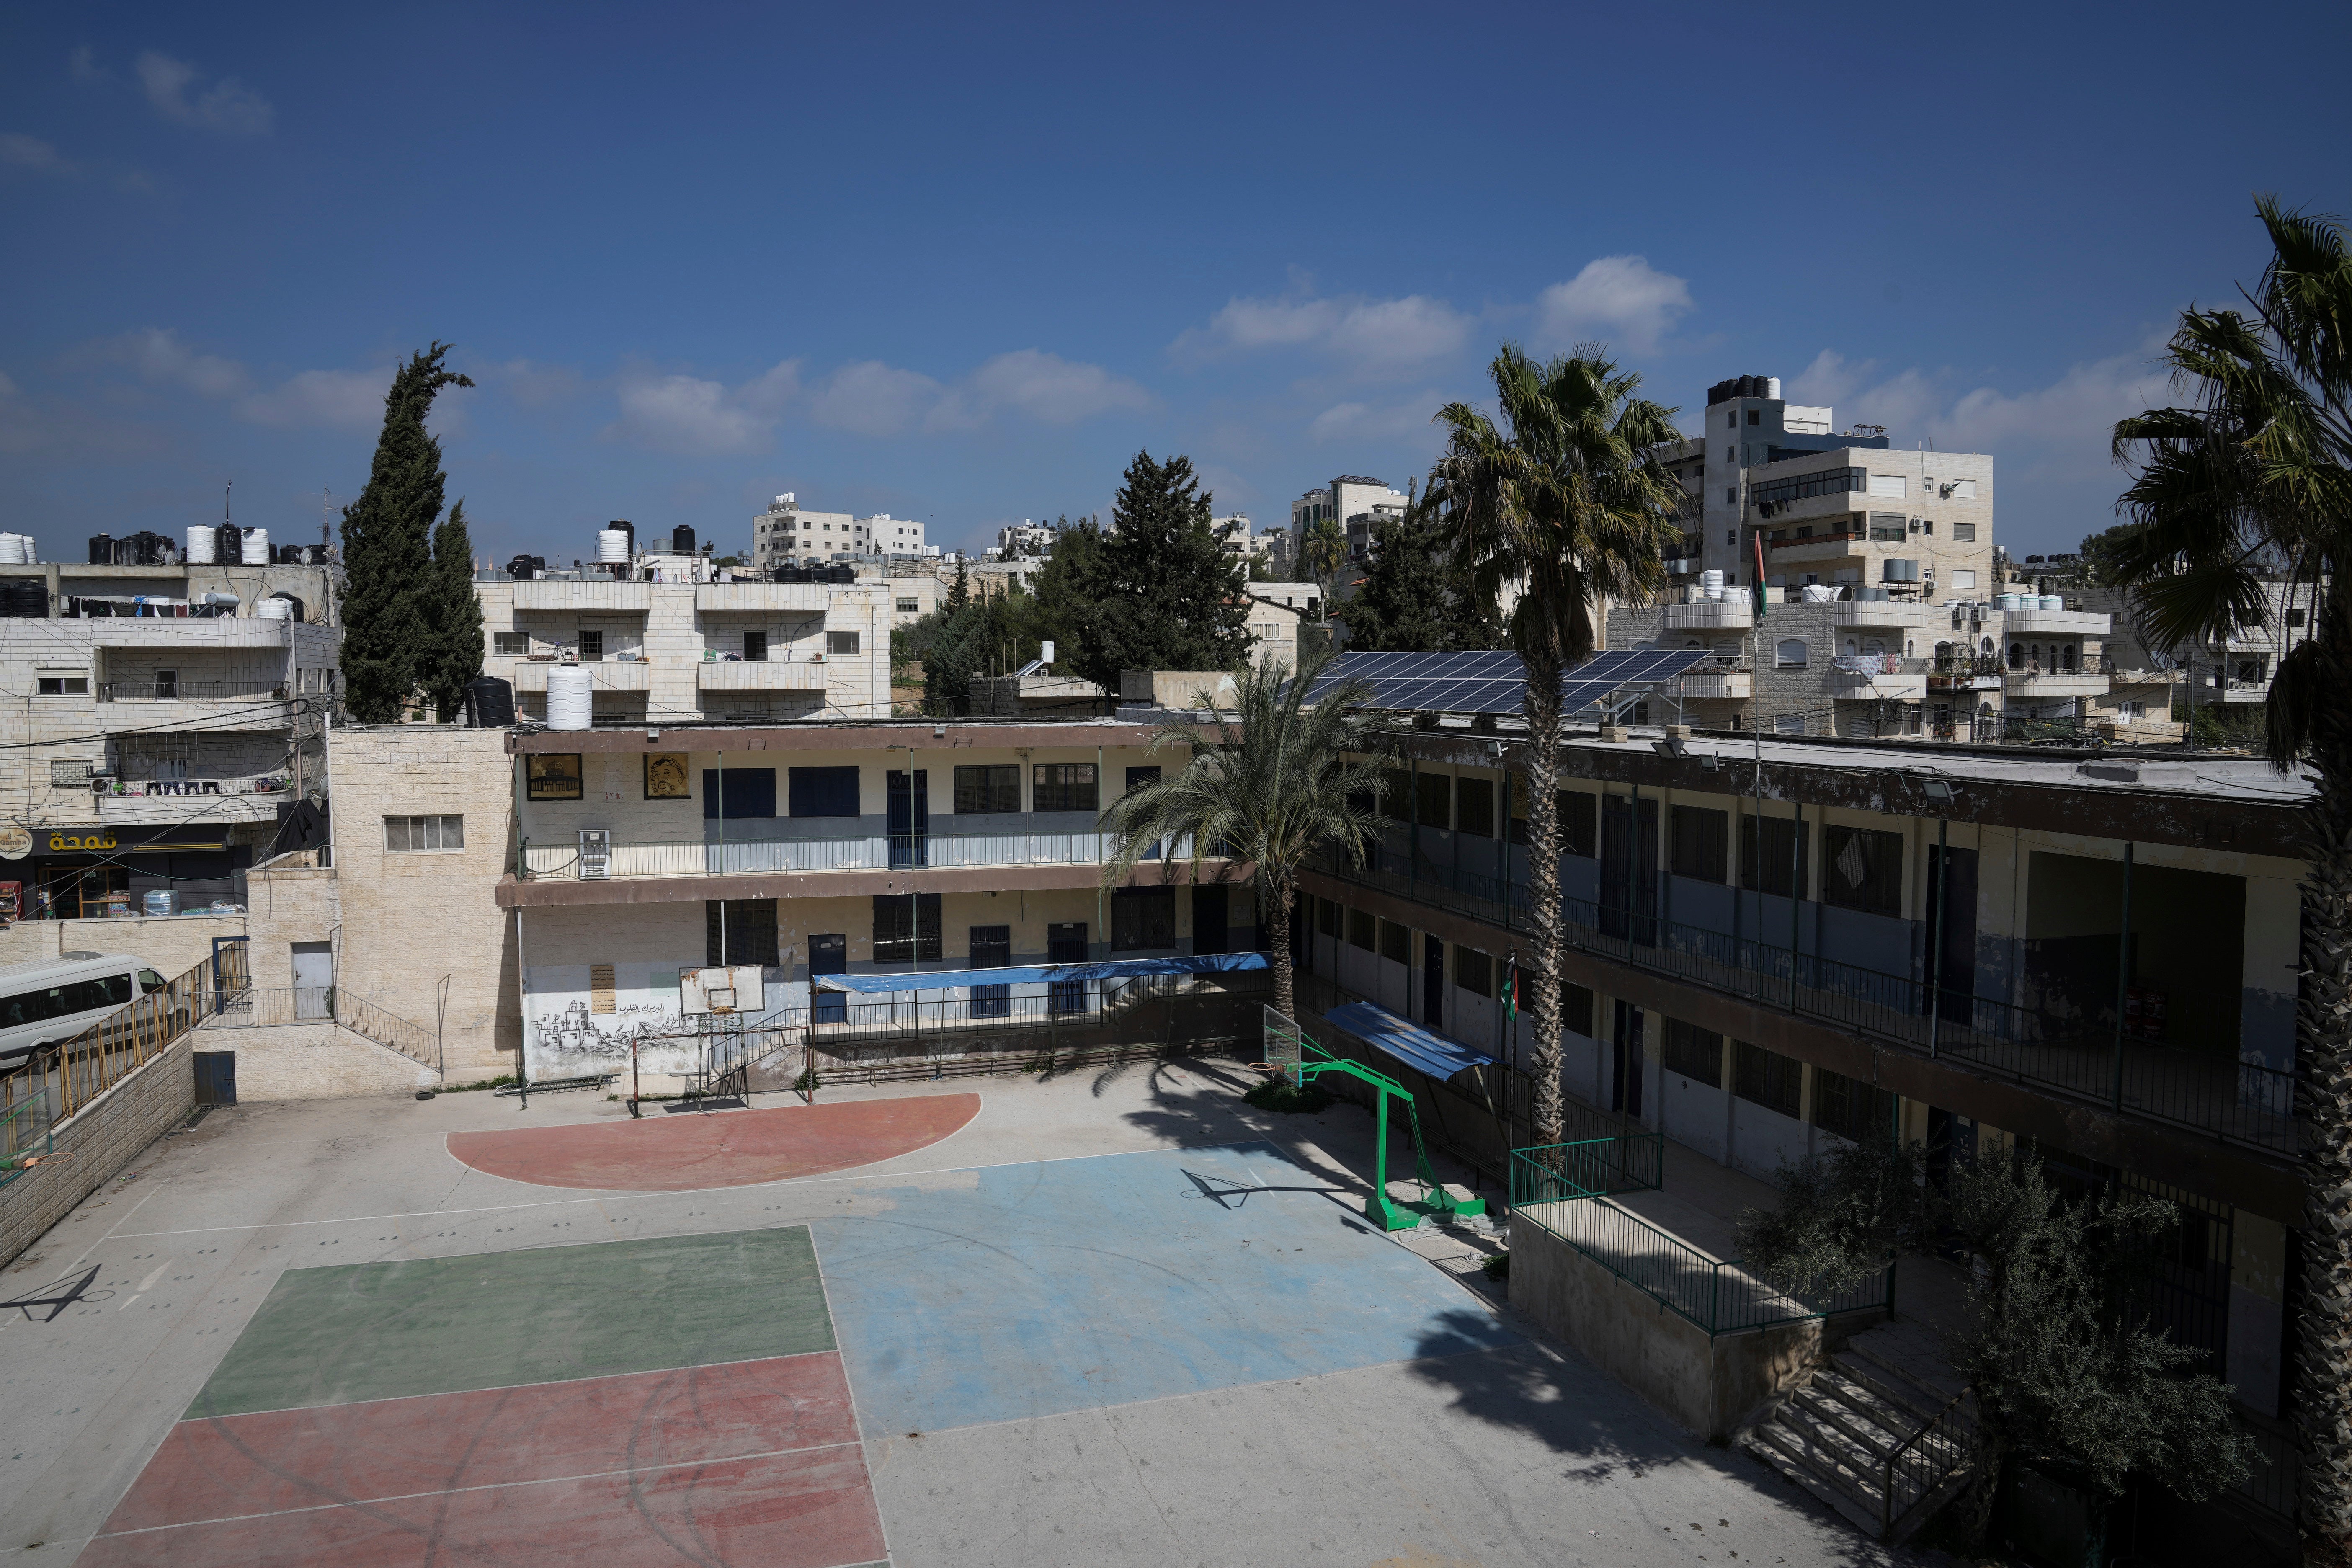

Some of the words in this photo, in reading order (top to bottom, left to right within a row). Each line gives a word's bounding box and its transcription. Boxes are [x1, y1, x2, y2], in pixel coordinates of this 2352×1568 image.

[49, 831, 116, 851] قمحة
[619, 1003, 641, 1015] بالقلوب
[642, 1003, 665, 1014] اليرموك
